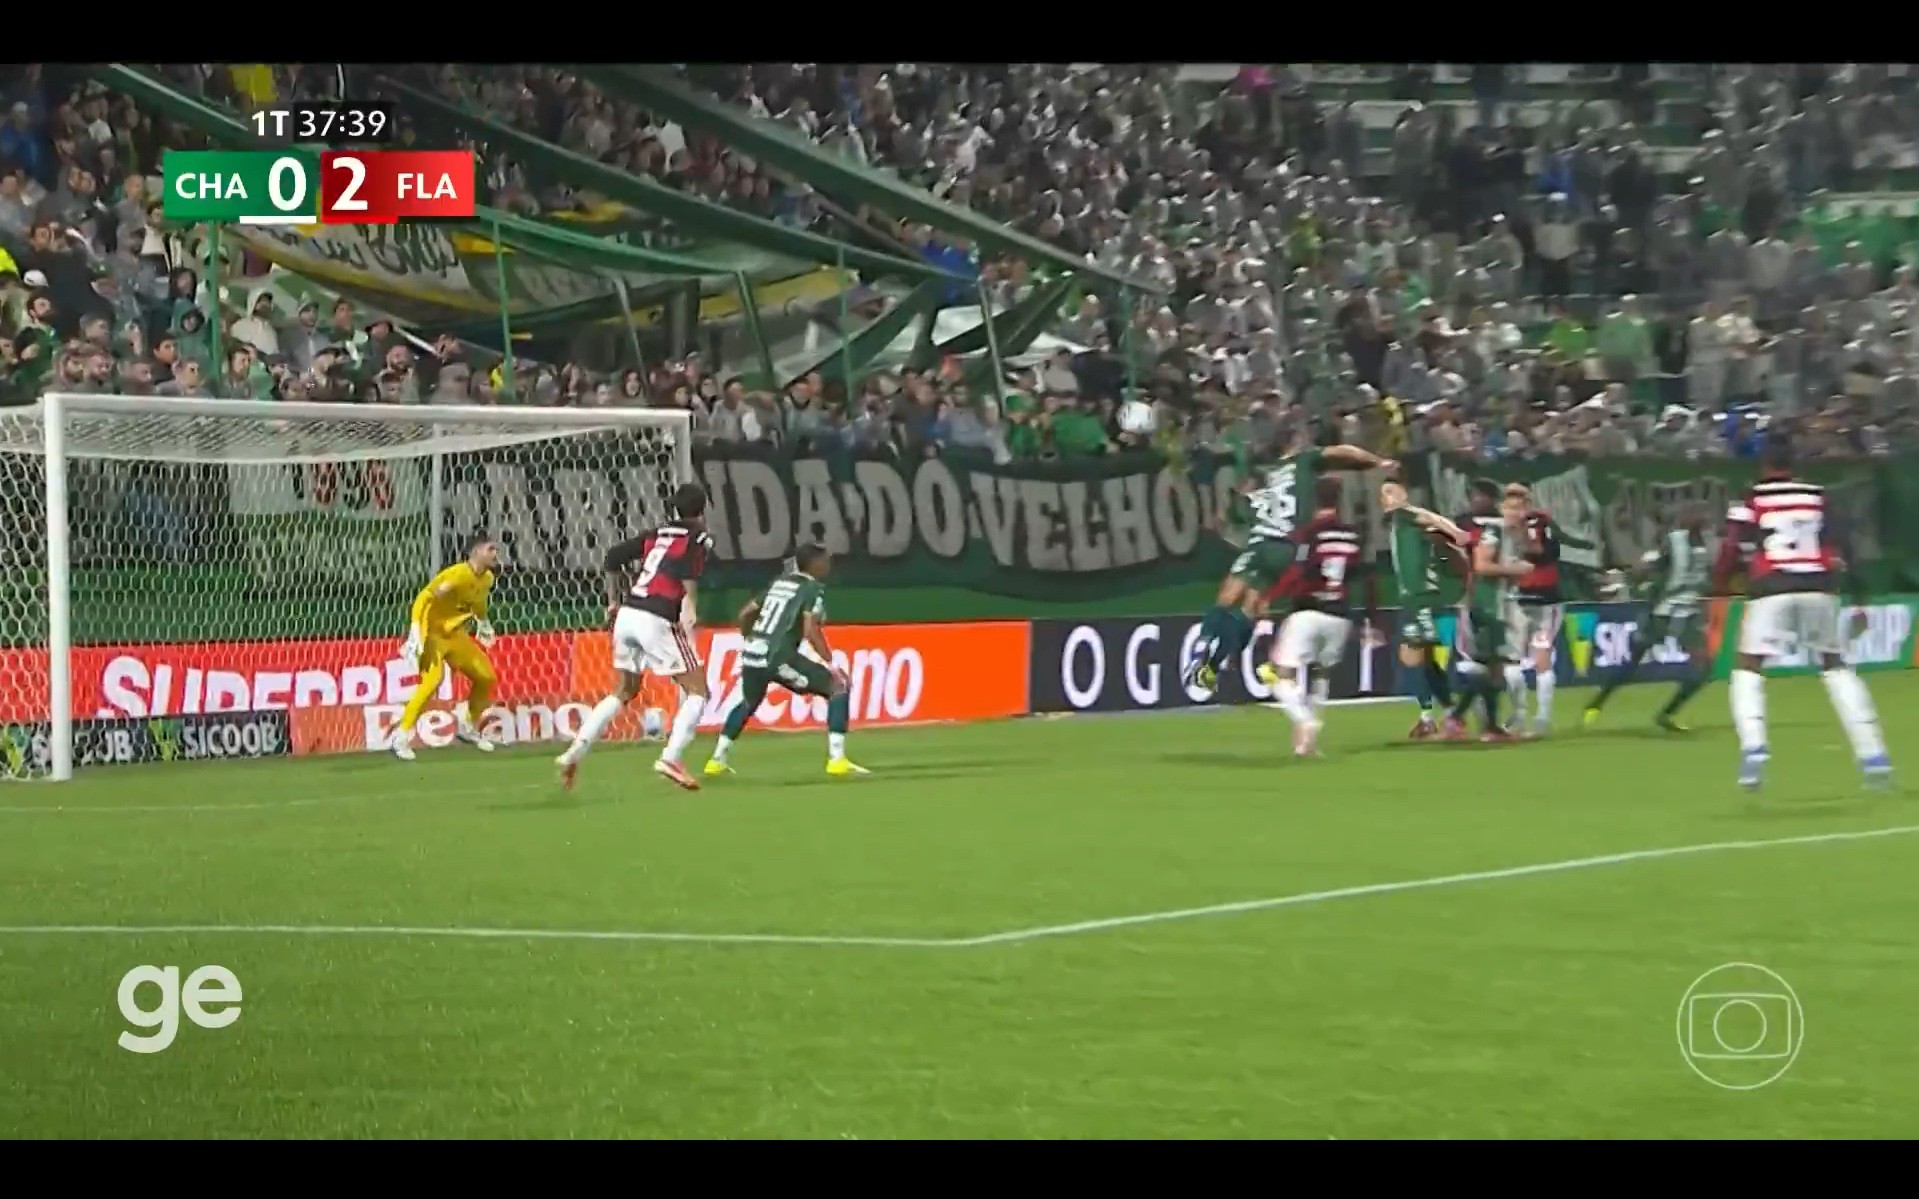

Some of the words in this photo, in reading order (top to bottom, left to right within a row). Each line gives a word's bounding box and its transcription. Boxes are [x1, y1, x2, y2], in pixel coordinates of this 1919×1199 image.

[854, 457, 968, 558] DO
[970, 464, 1200, 572] VELHO
[183, 718, 279, 760] SICOOB
